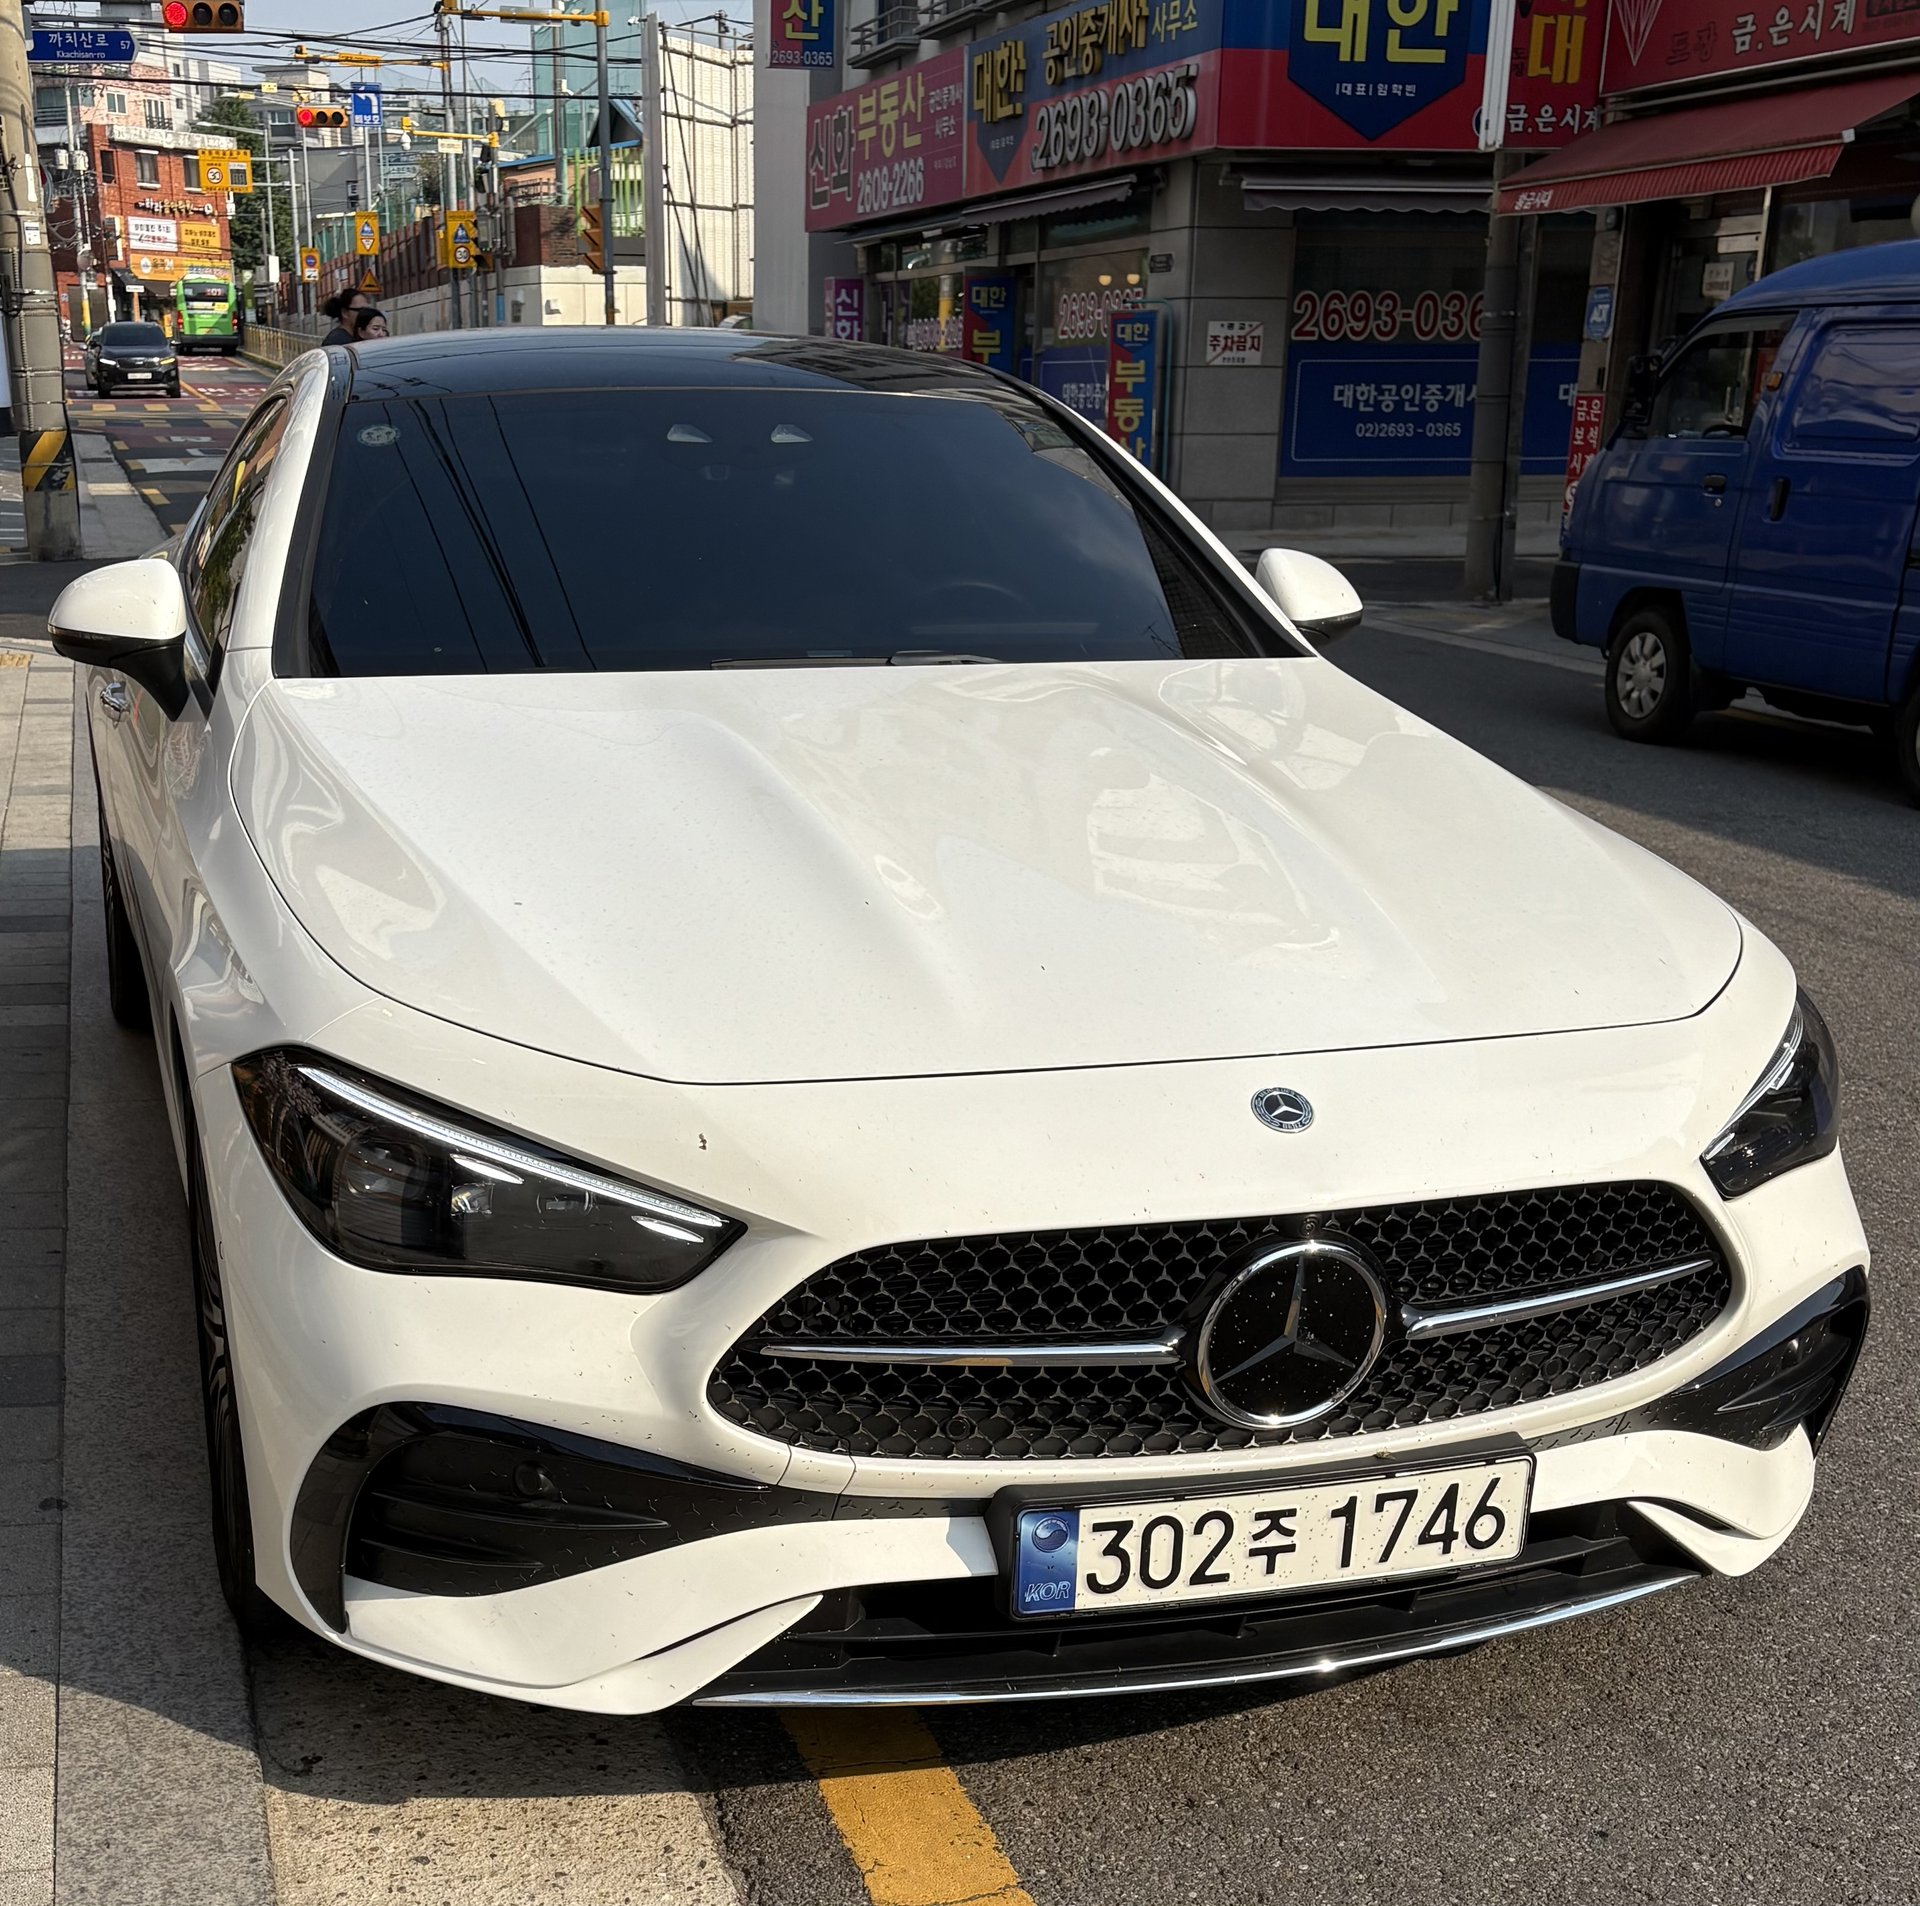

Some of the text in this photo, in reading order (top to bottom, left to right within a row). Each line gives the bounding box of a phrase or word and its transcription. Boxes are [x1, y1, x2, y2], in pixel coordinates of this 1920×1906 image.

[49, 32, 130, 49] 까치산로 57
[1043, 0, 1198, 85] 공인중개사 사무소
[1527, 0, 1588, 84] 대
[56, 51, 105, 59] Kkachisan-ro
[771, 50, 832, 66] 2693-0365
[973, 40, 1027, 123] 대한
[1035, 63, 1199, 170] 2693-0365
[809, 71, 925, 210] 신화 부동산
[857, 156, 924, 213] 2608-2266
[457, 250, 469, 260] 30
[971, 286, 1006, 308] 대한
[1588, 303, 1611, 323] ADT
[1115, 321, 1150, 342] 대한
[1209, 335, 1261, 352] 주차금지
[1086, 1476, 1507, 1596] 302주 1746
[1023, 1579, 1073, 1603] KOR
